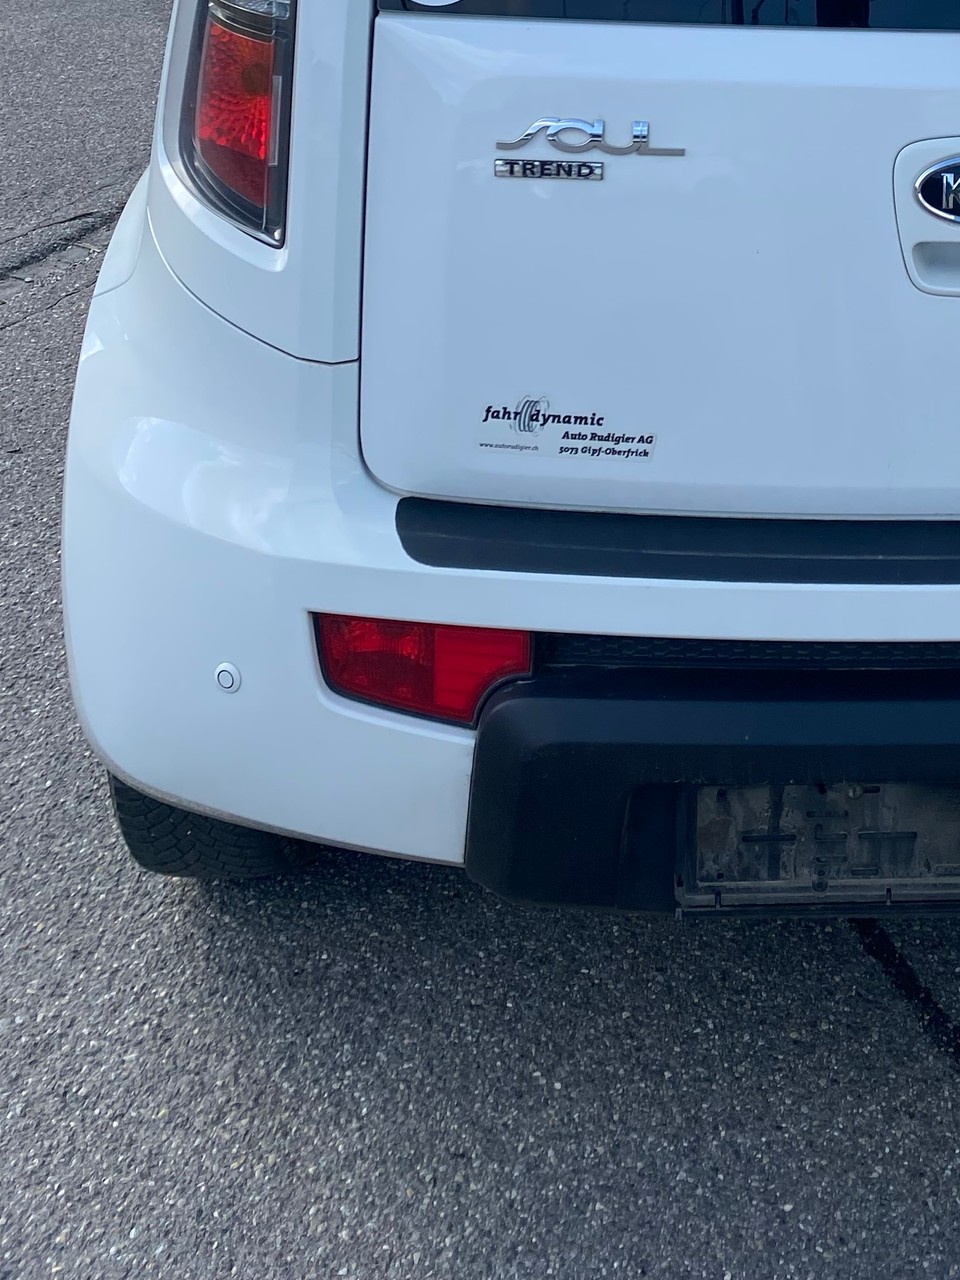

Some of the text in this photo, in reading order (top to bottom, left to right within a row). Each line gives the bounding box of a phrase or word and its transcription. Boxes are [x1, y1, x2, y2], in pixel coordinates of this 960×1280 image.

[503, 161, 596, 179] TREND
[561, 431, 654, 445] Auto Rudigier AG
[558, 446, 649, 458] 5073 Gipf-Oberfrick
